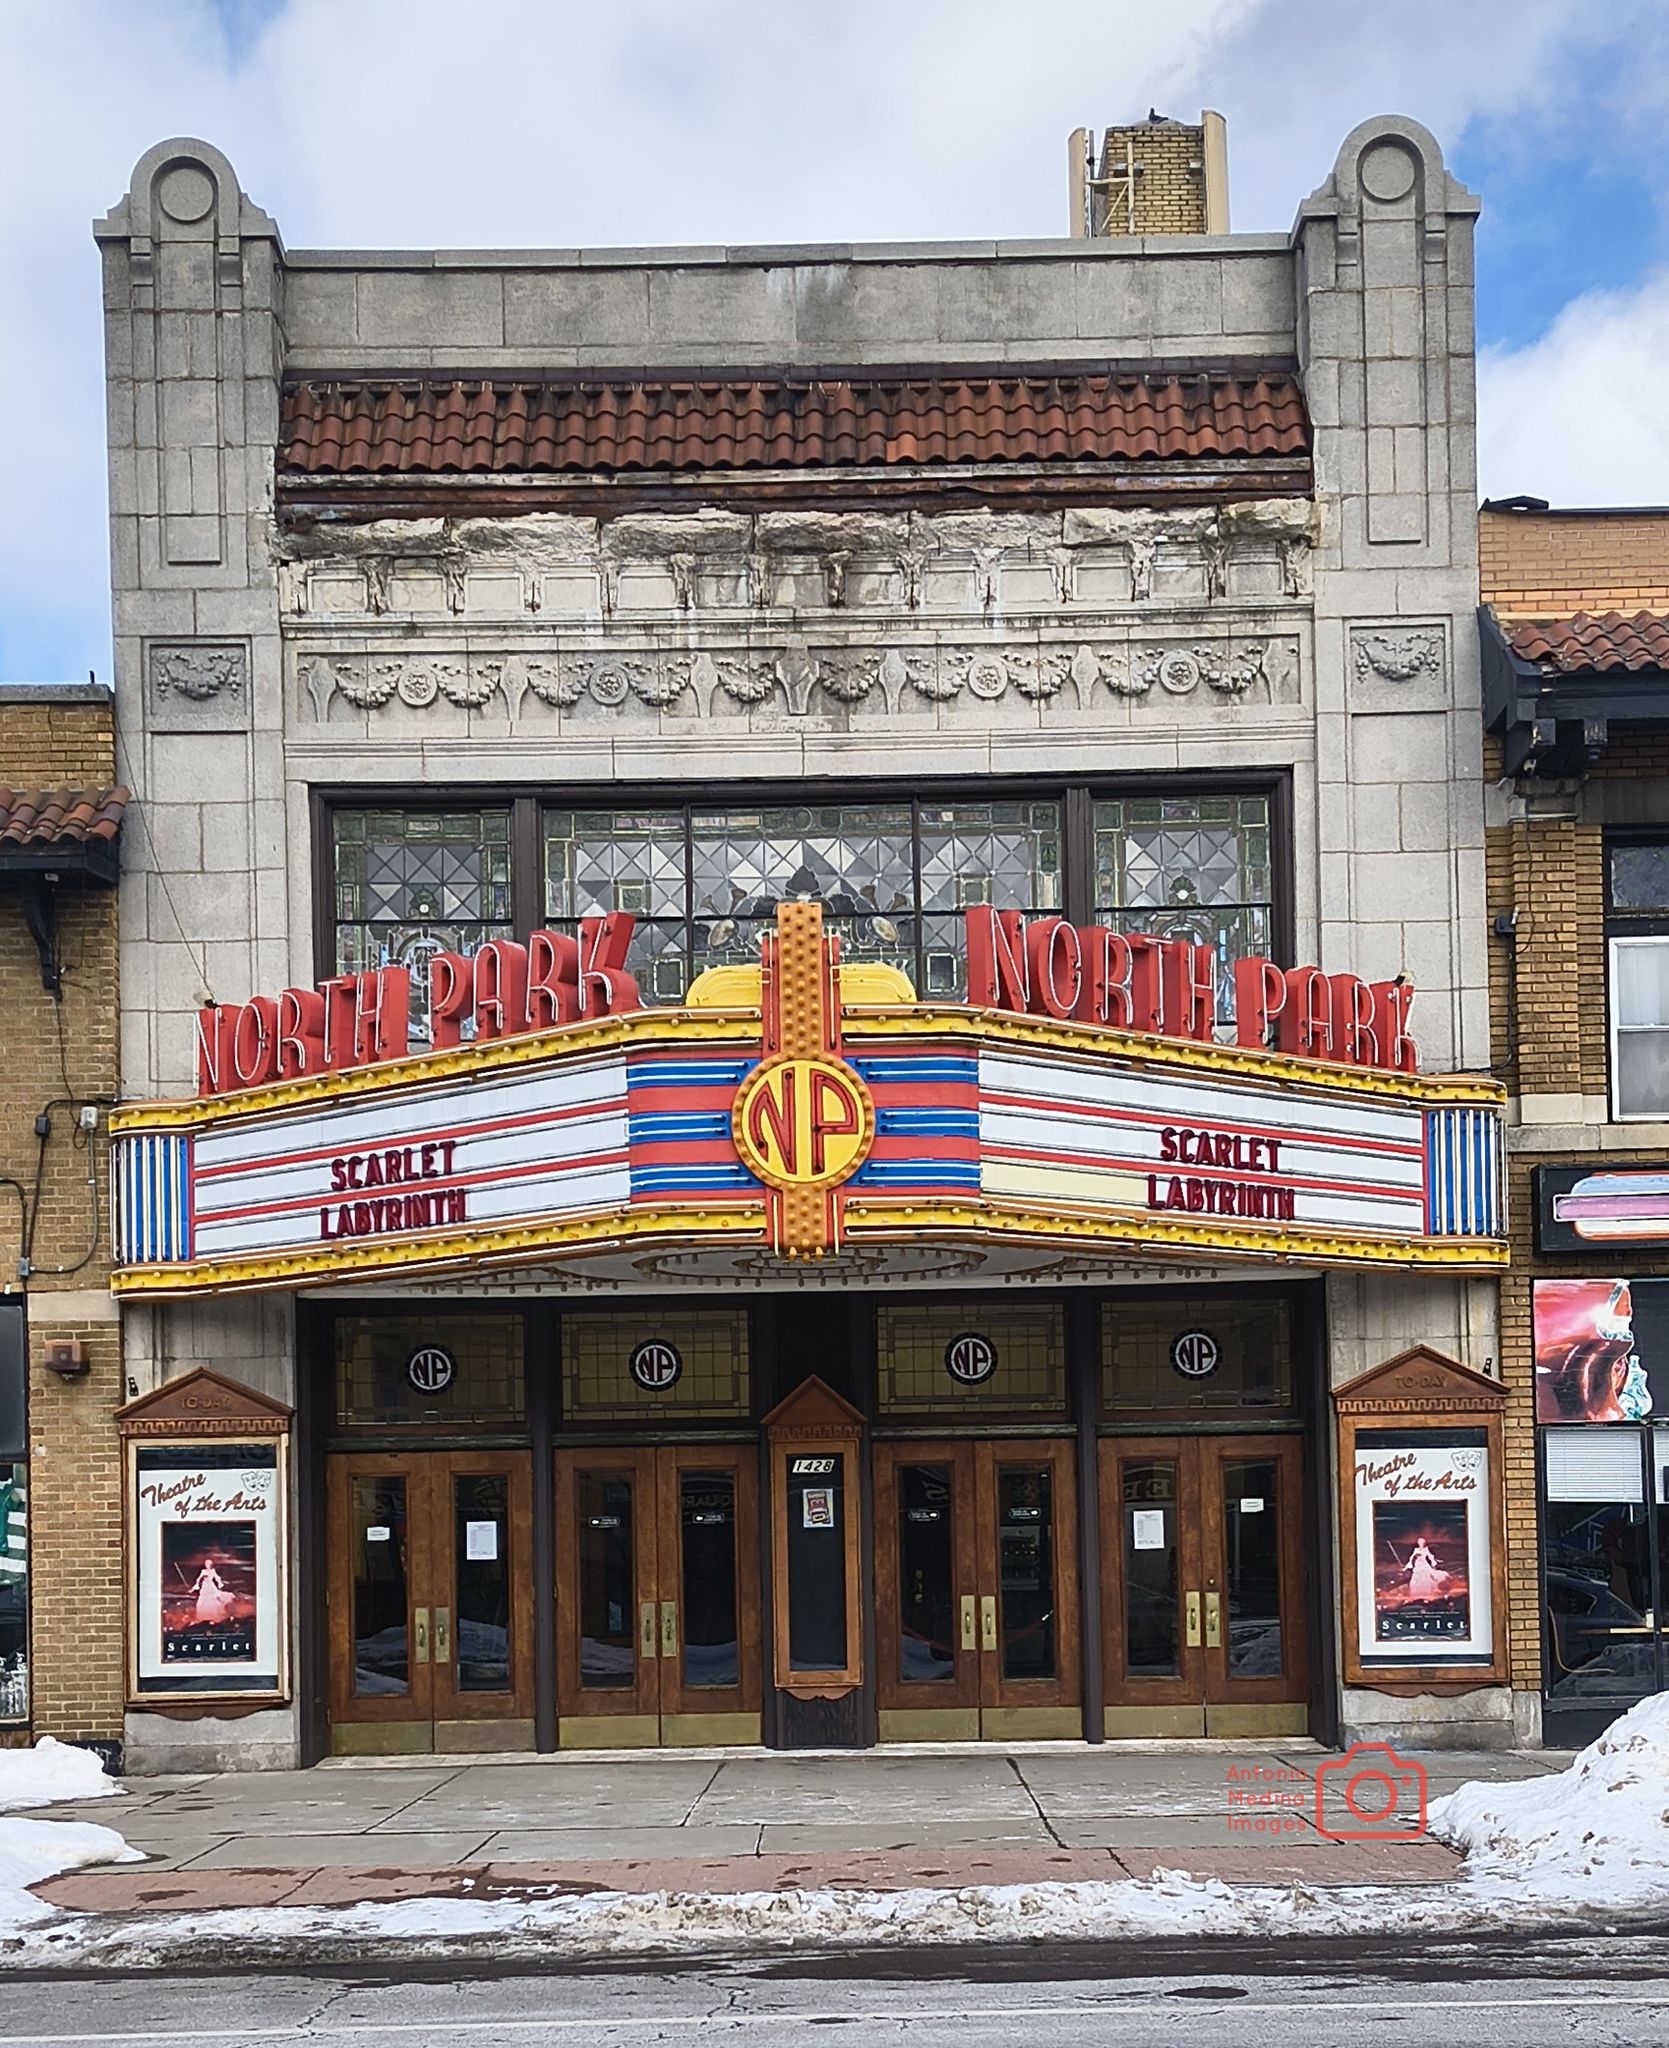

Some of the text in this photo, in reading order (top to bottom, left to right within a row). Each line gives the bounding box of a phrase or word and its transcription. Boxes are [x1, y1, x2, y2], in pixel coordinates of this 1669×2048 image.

[193, 912, 647, 1096] NORTH PARK
[966, 904, 1422, 1073] NORTH PARK
[749, 1066, 860, 1176] NP
[330, 1140, 457, 1191] SCARLET
[1160, 1126, 1282, 1173] SCARLET
[320, 1188, 467, 1240] LABYRINTH
[1147, 1174, 1295, 1221] LABYRINTH
[796, 1460, 832, 1472] 1428
[1355, 1453, 1417, 1486] Theatre
[1384, 1470, 1477, 1497] of the Arts
[140, 1473, 207, 1507] Theatre
[174, 1491, 267, 1519] of the Arts
[1382, 1620, 1465, 1630] Scarlet
[167, 1641, 250, 1652] Scarlet
